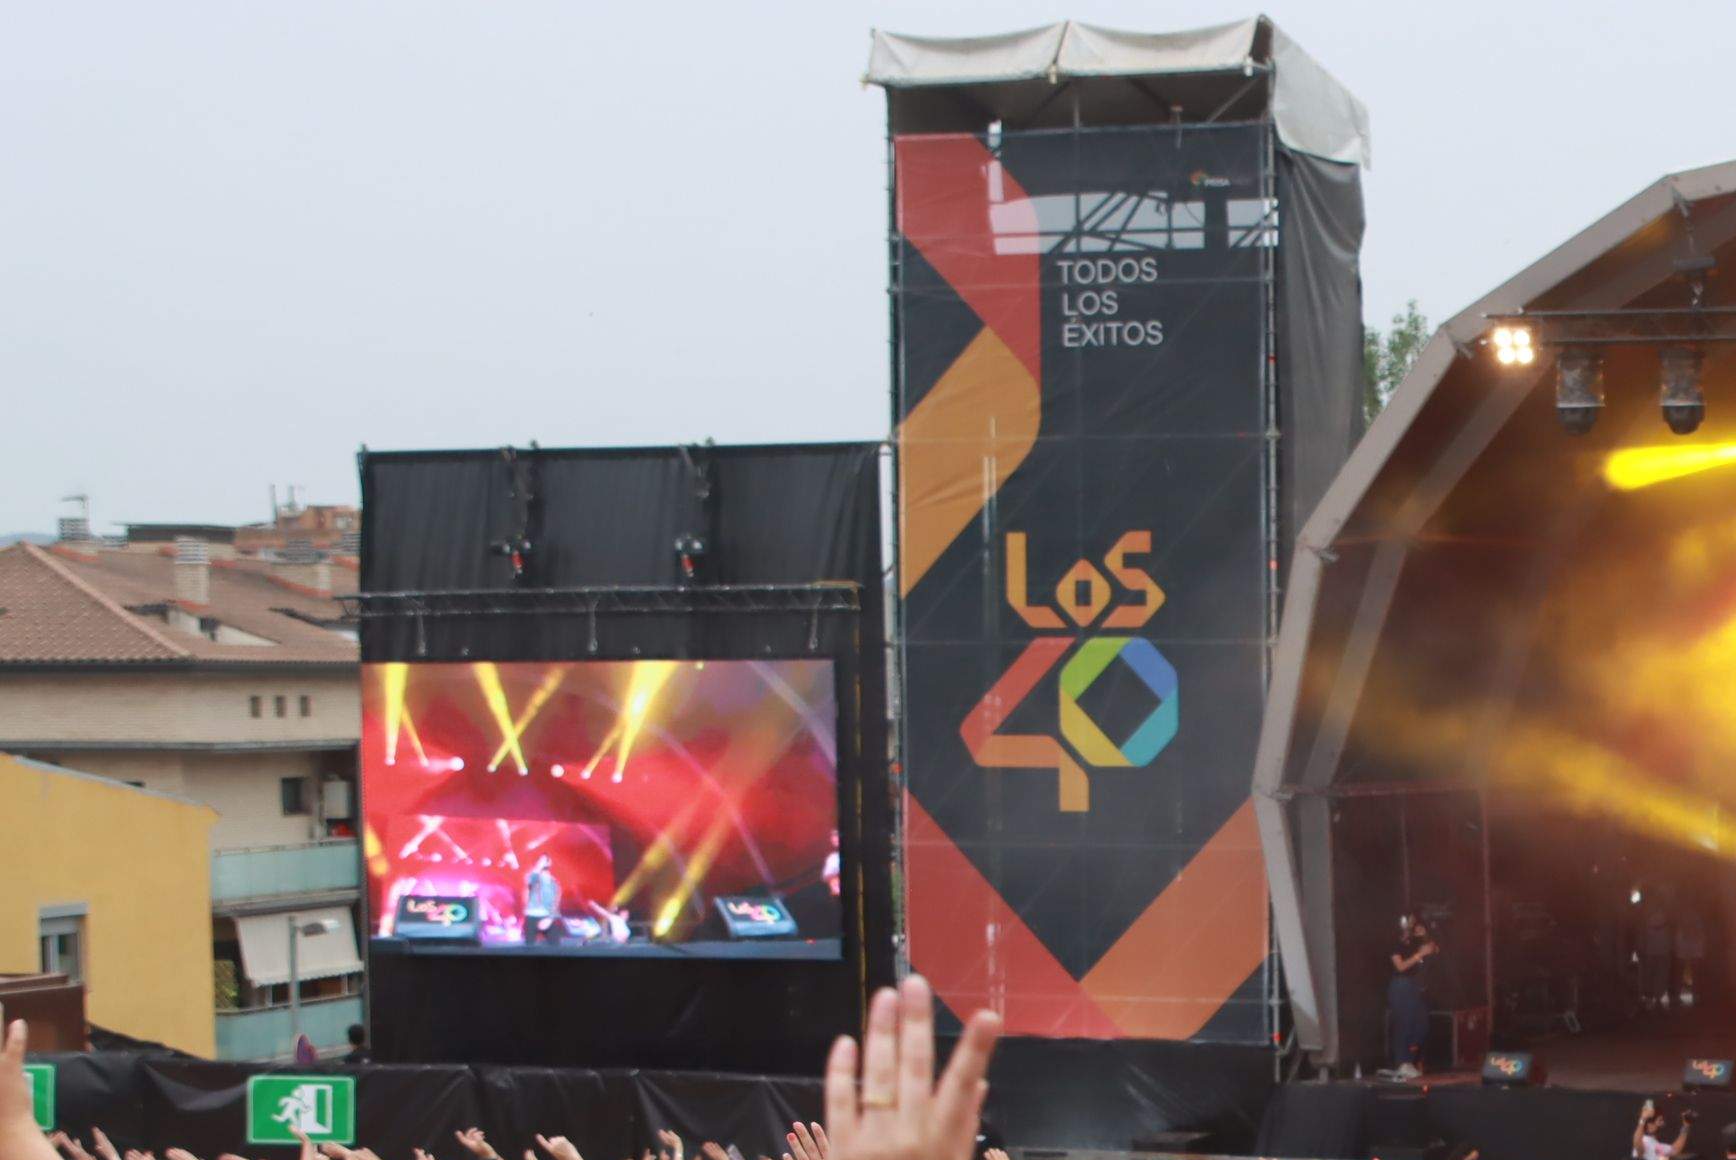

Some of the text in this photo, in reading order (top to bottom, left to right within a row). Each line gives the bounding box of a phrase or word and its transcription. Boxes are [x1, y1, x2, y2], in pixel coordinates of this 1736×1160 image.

[1057, 257, 1158, 285] TODOS
[1063, 290, 1119, 316] LOS
[1063, 317, 1164, 348] ÉXITOS
[959, 637, 1179, 812] 40
